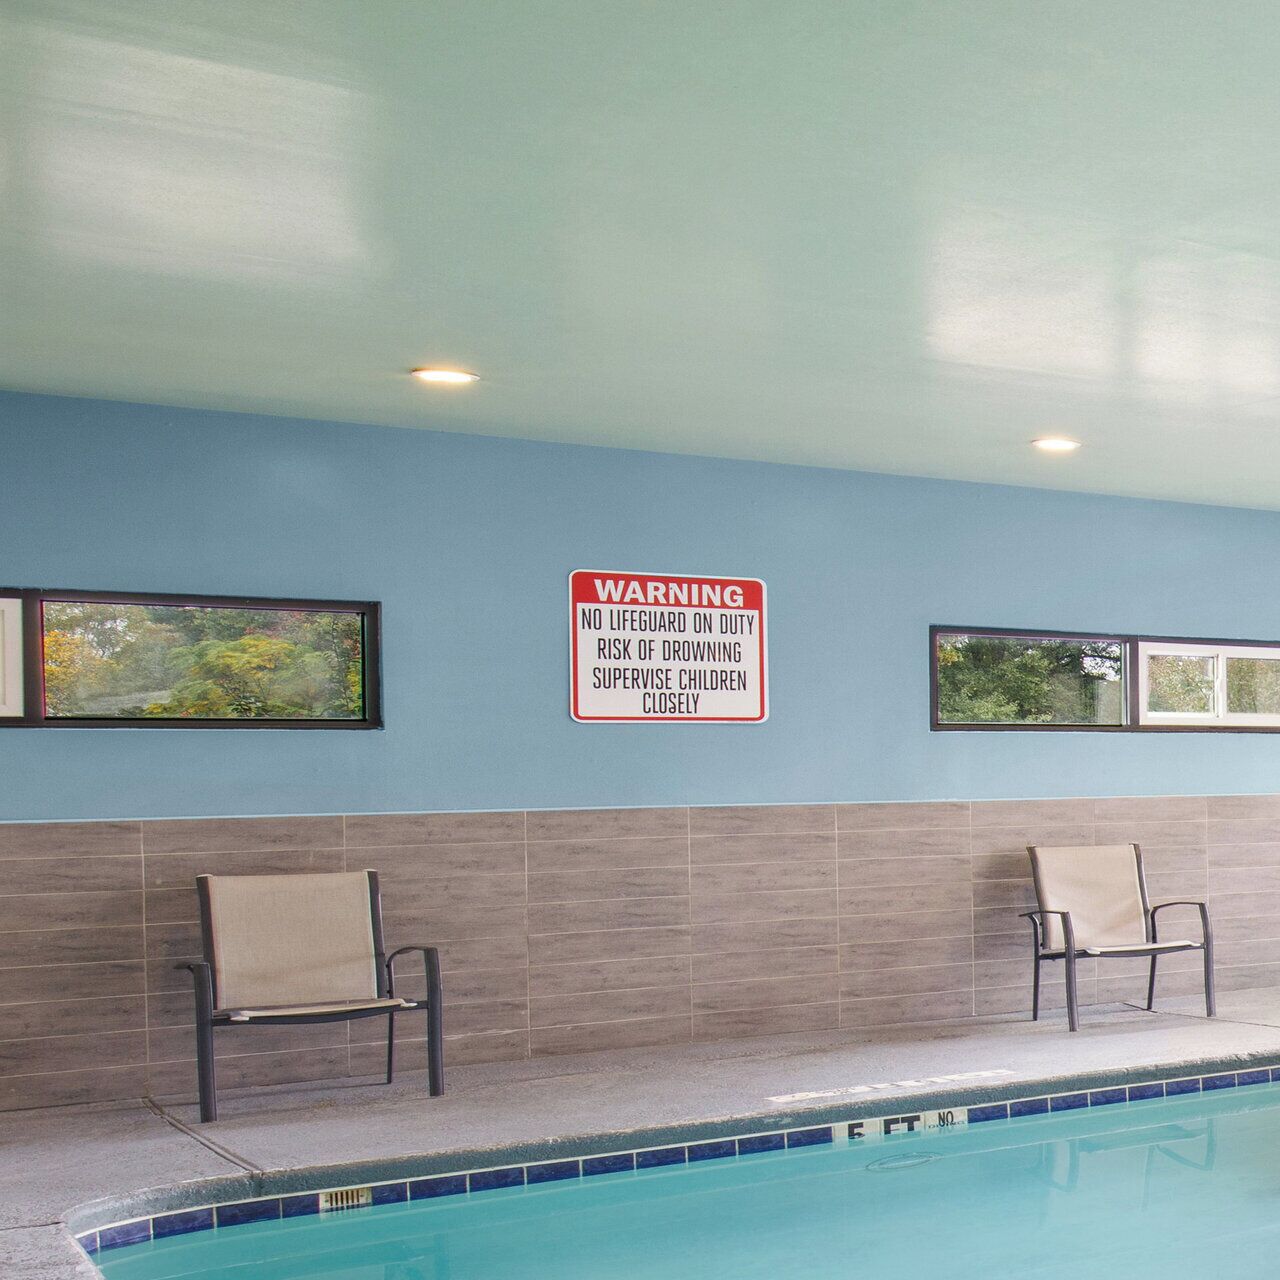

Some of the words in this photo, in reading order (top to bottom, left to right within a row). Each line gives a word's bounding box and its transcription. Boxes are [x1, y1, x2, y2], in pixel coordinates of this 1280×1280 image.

[594, 579, 744, 607] WARNING
[581, 608, 602, 630] NO
[610, 609, 686, 633] LIFEGUARD
[693, 612, 713, 634] ON
[720, 613, 755, 635] DUTY
[597, 638, 632, 660] RISK
[638, 640, 655, 661] OF
[662, 640, 742, 663] DROWNING
[593, 667, 672, 690] SUPERVISE
[679, 669, 747, 691] CHILDREN
[643, 692, 700, 714] CLOSELY
[883, 1115, 921, 1135] FT
[938, 1111, 954, 1127] NO
